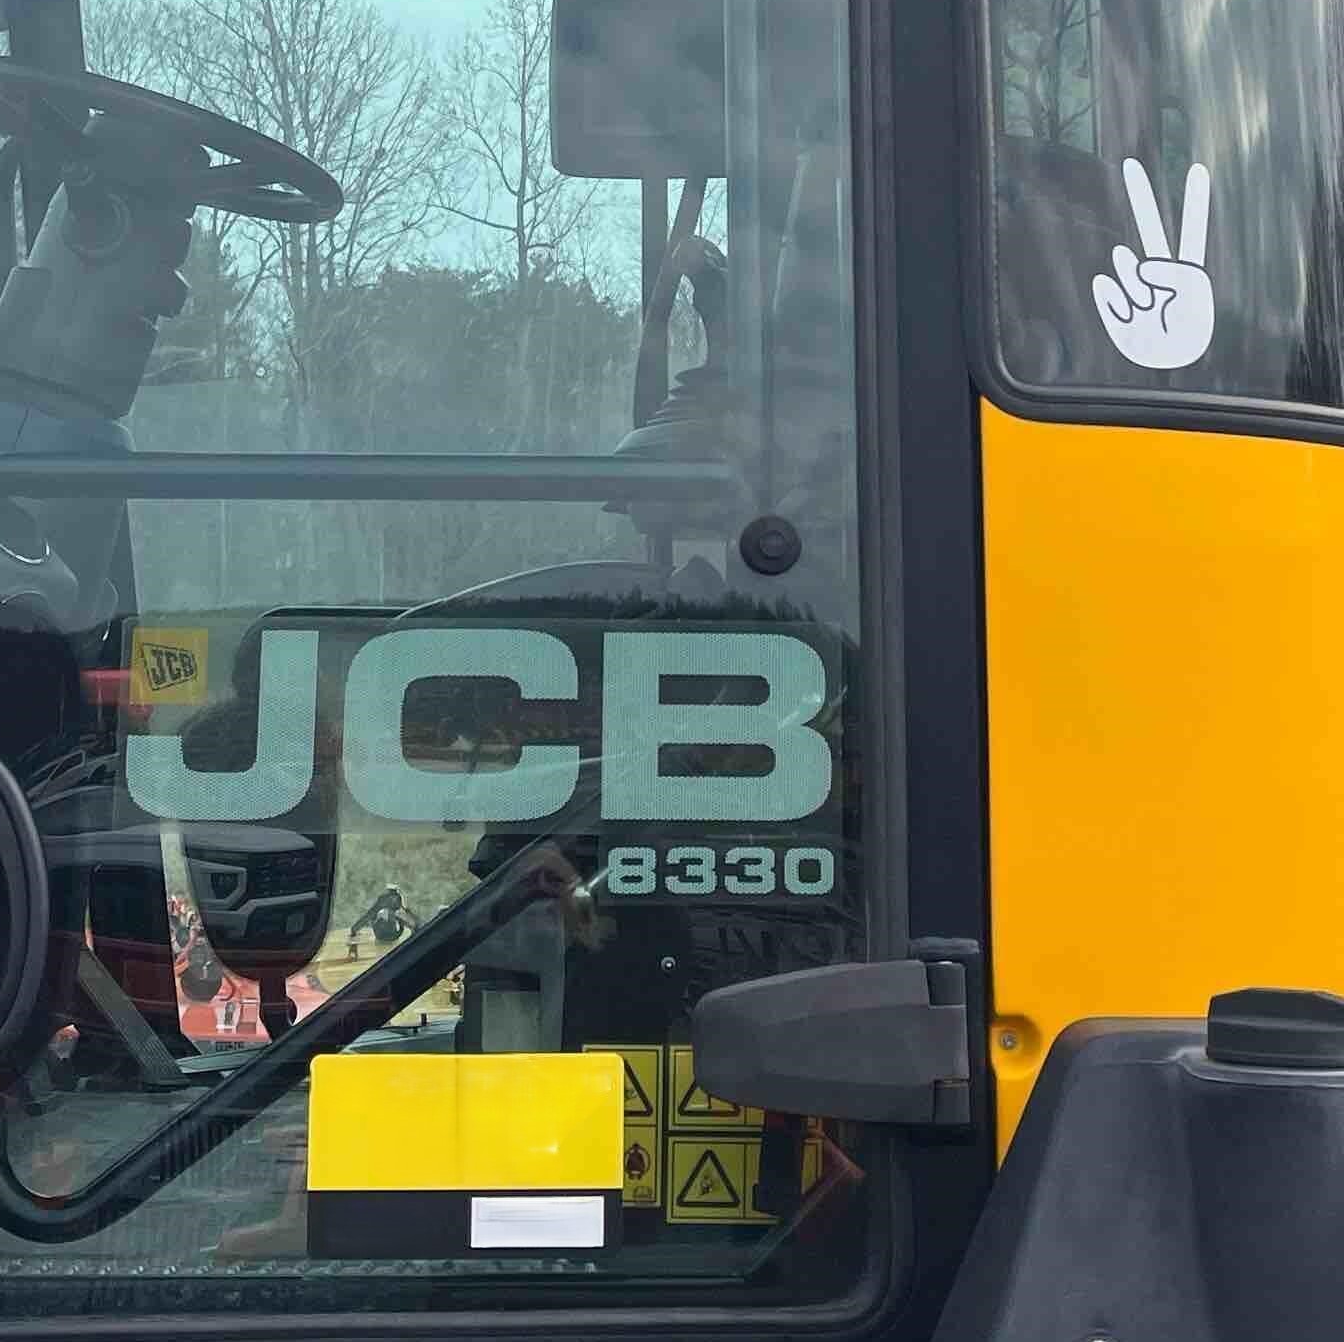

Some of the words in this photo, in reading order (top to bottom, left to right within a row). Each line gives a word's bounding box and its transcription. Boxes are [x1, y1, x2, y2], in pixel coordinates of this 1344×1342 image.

[151, 648, 195, 686] JCB
[125, 629, 833, 821] JCB
[608, 846, 834, 896] 8330
